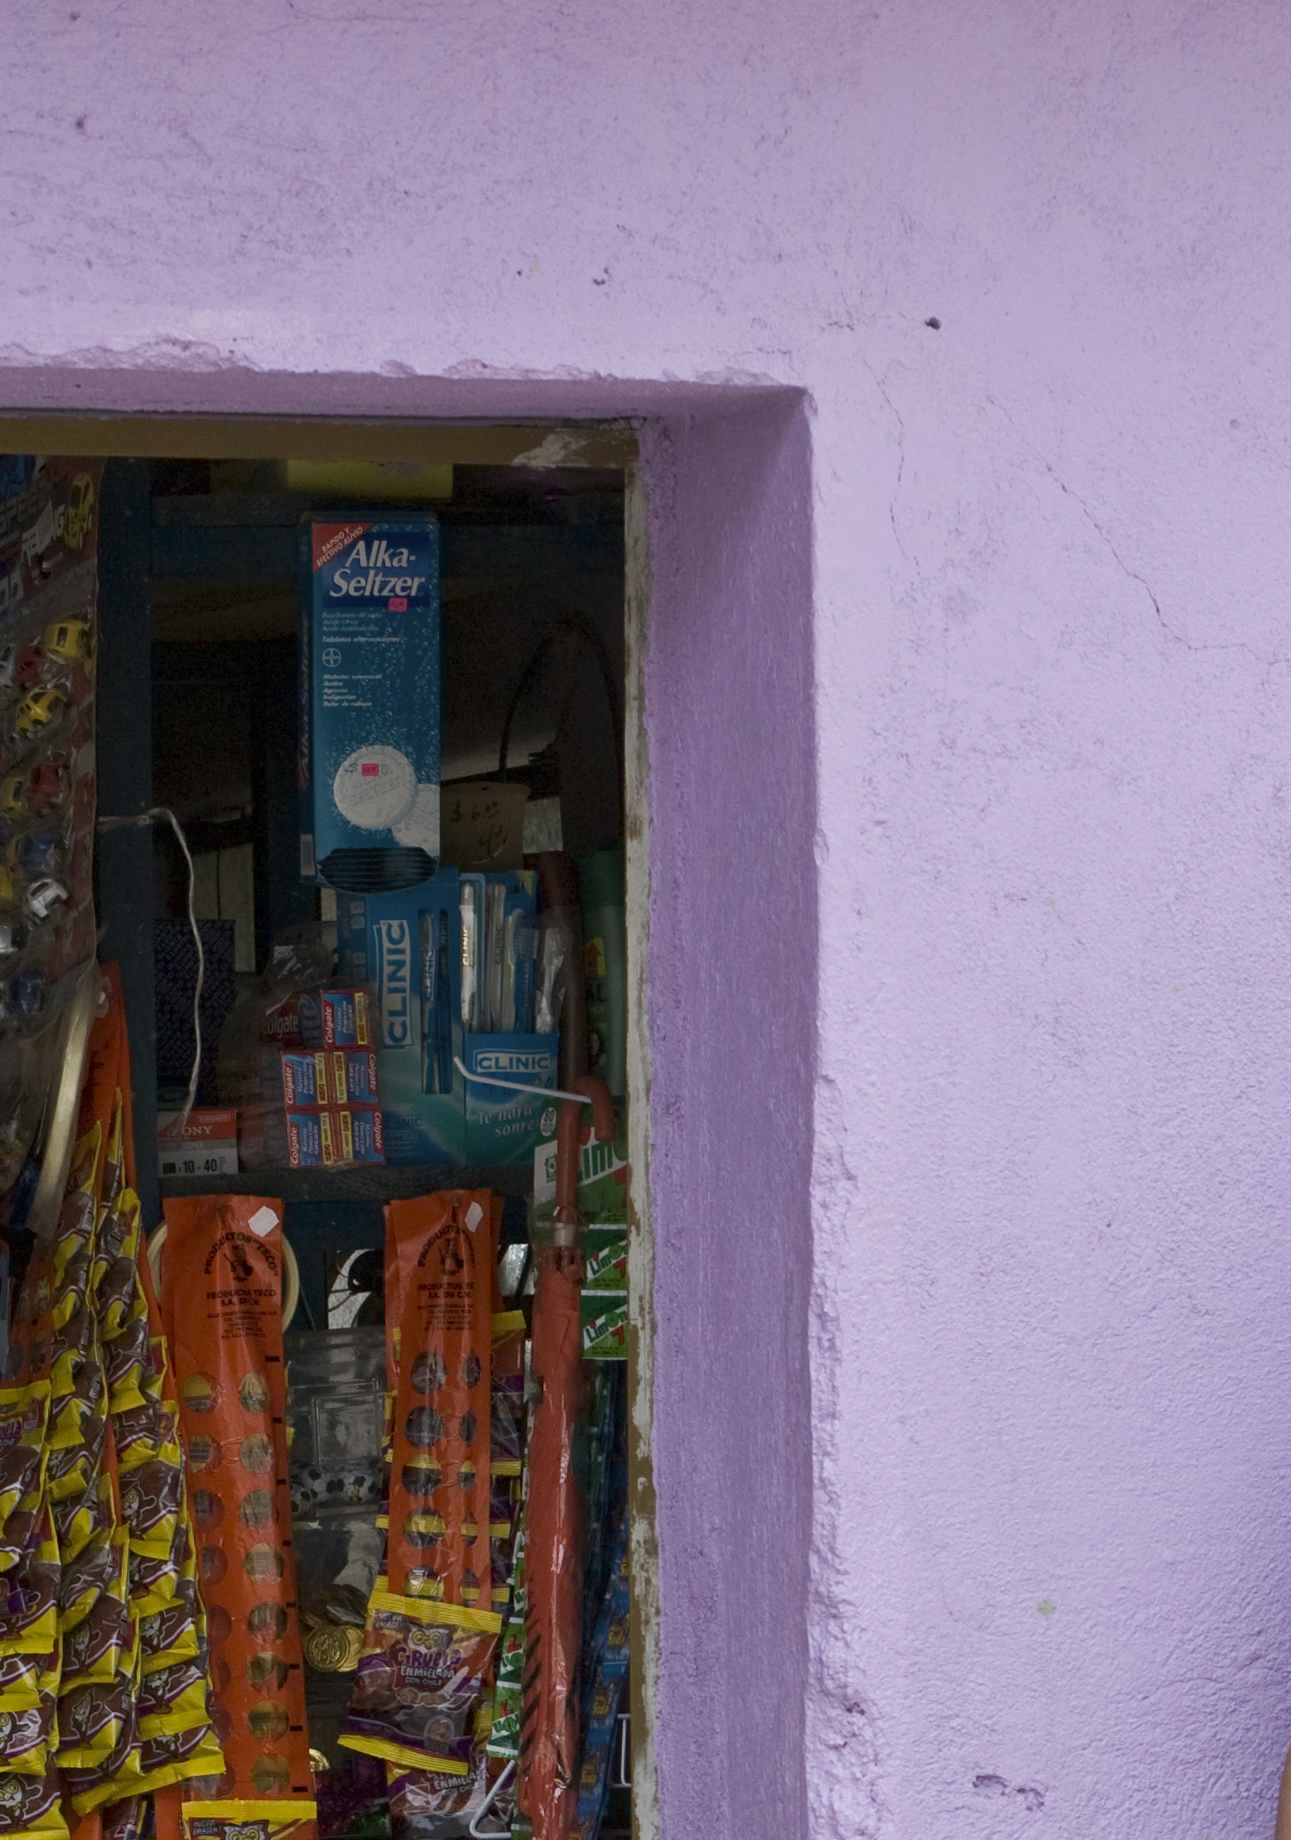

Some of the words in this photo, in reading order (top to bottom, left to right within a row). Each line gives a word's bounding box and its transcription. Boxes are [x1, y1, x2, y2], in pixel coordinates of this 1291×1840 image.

[345, 539, 417, 568] Alka-
[329, 567, 425, 598] Seltzer
[386, 920, 407, 1043] CLINIC
[264, 1014, 298, 1036] olgate
[323, 1005, 334, 1044] Colgate
[478, 1056, 549, 1071] CLINIC
[284, 1062, 295, 1104] Colgate
[289, 1125, 299, 1165] Colgate
[373, 1111, 384, 1150] Colgate
[204, 1158, 218, 1173] 40
